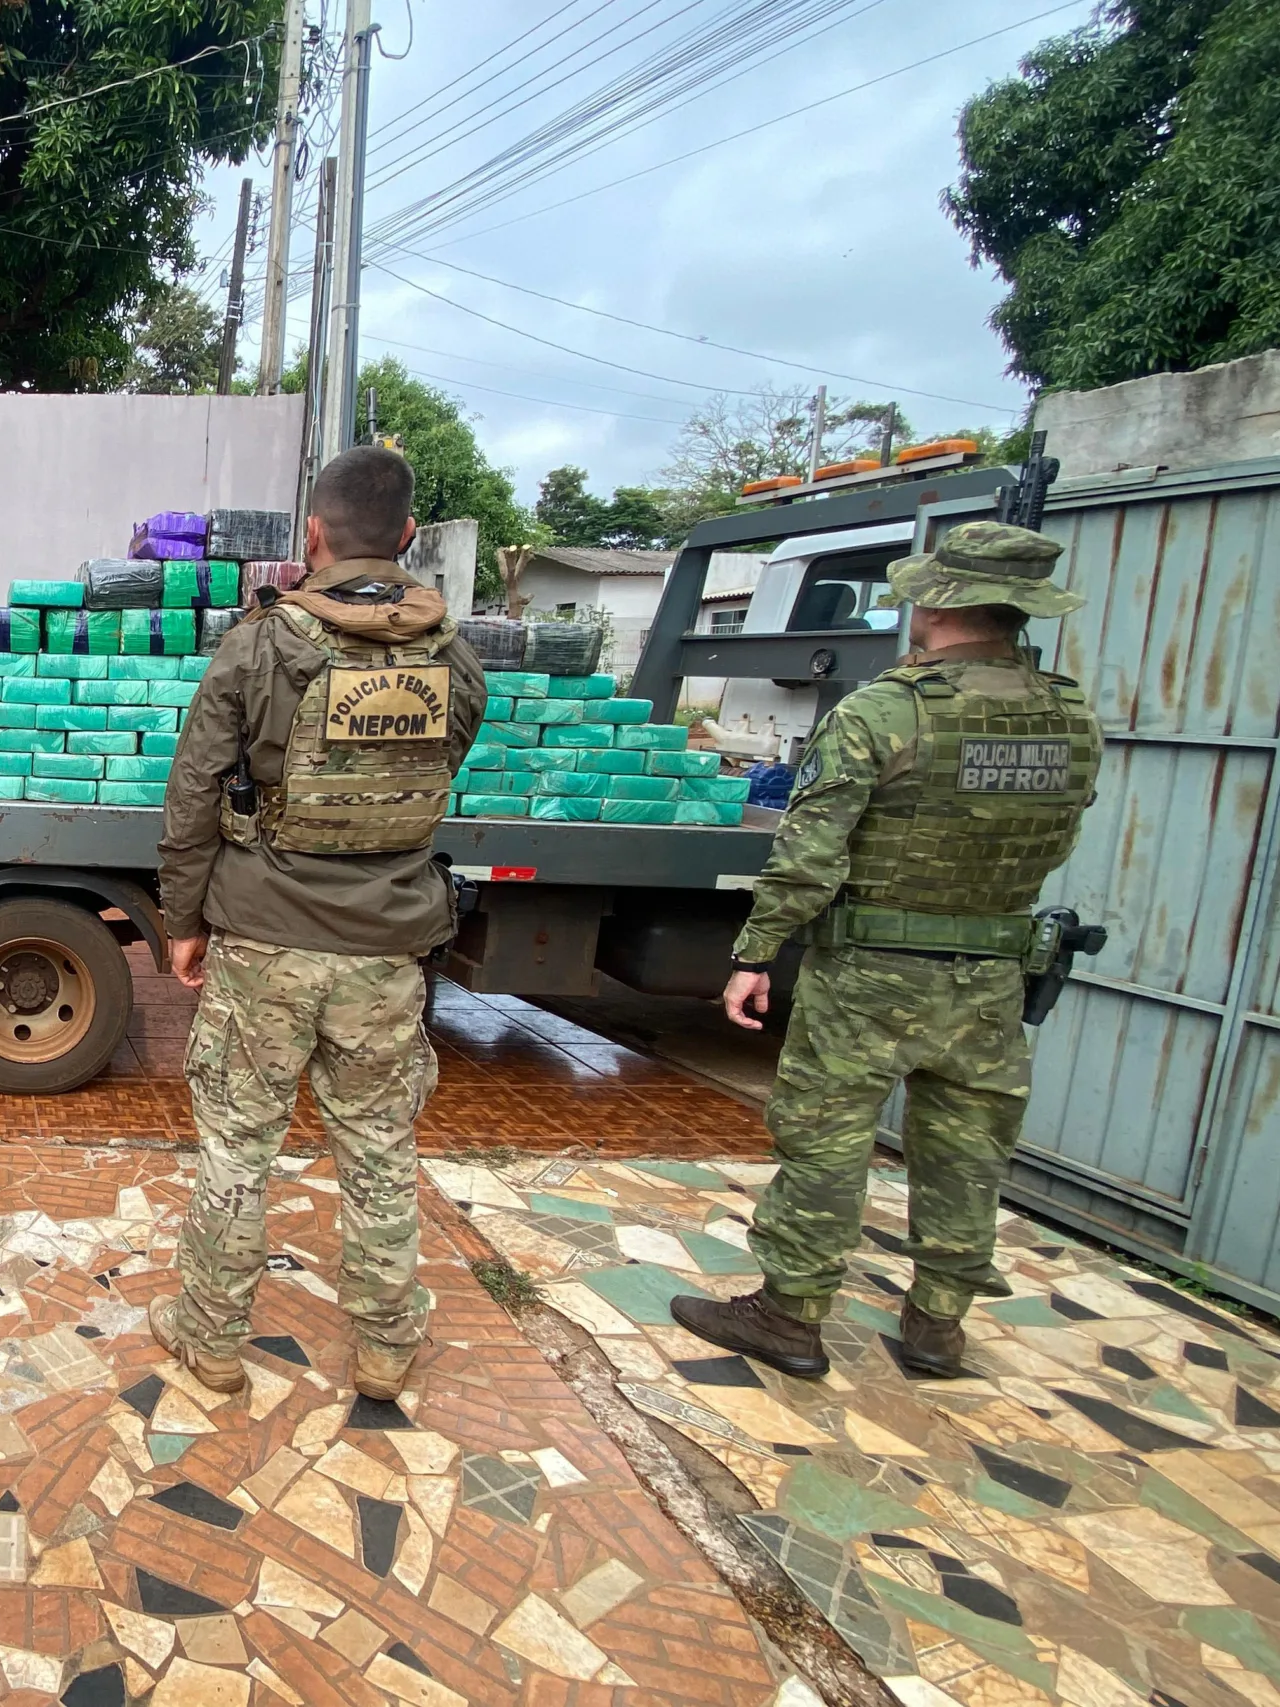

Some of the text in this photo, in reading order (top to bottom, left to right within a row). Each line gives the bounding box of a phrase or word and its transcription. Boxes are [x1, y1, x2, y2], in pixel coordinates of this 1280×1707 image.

[329, 673, 446, 726] POLICIA FEDERAL
[348, 713, 427, 737] NEPOM
[1020, 744, 1068, 768] MILITAR
[961, 767, 1067, 791] BPFRON
